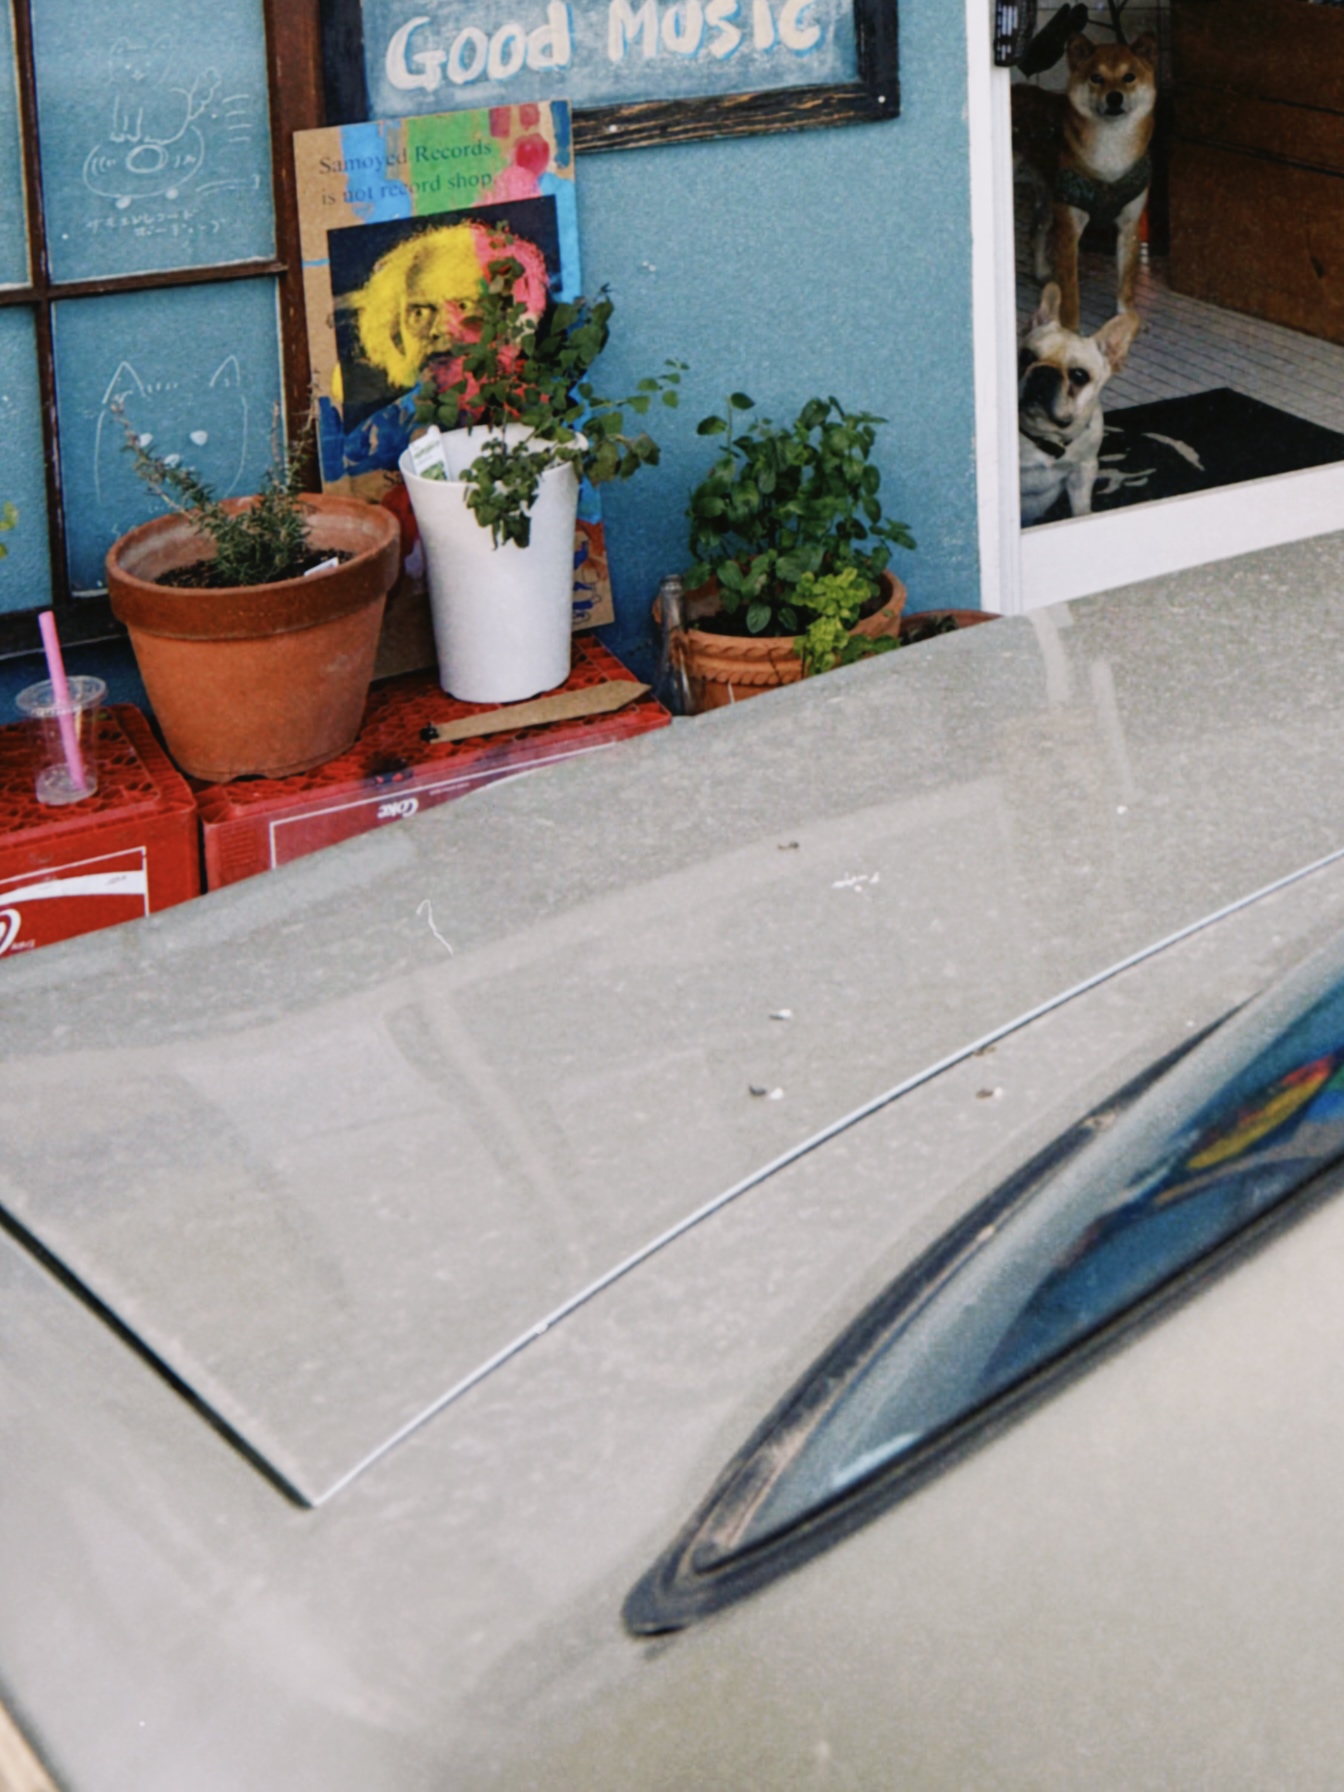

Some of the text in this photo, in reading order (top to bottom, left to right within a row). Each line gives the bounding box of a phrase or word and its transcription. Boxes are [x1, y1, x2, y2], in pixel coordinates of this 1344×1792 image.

[319, 139, 493, 174] Samoyed Records
[321, 190, 337, 206] is
[344, 187, 375, 204] not
[380, 175, 441, 198] record
